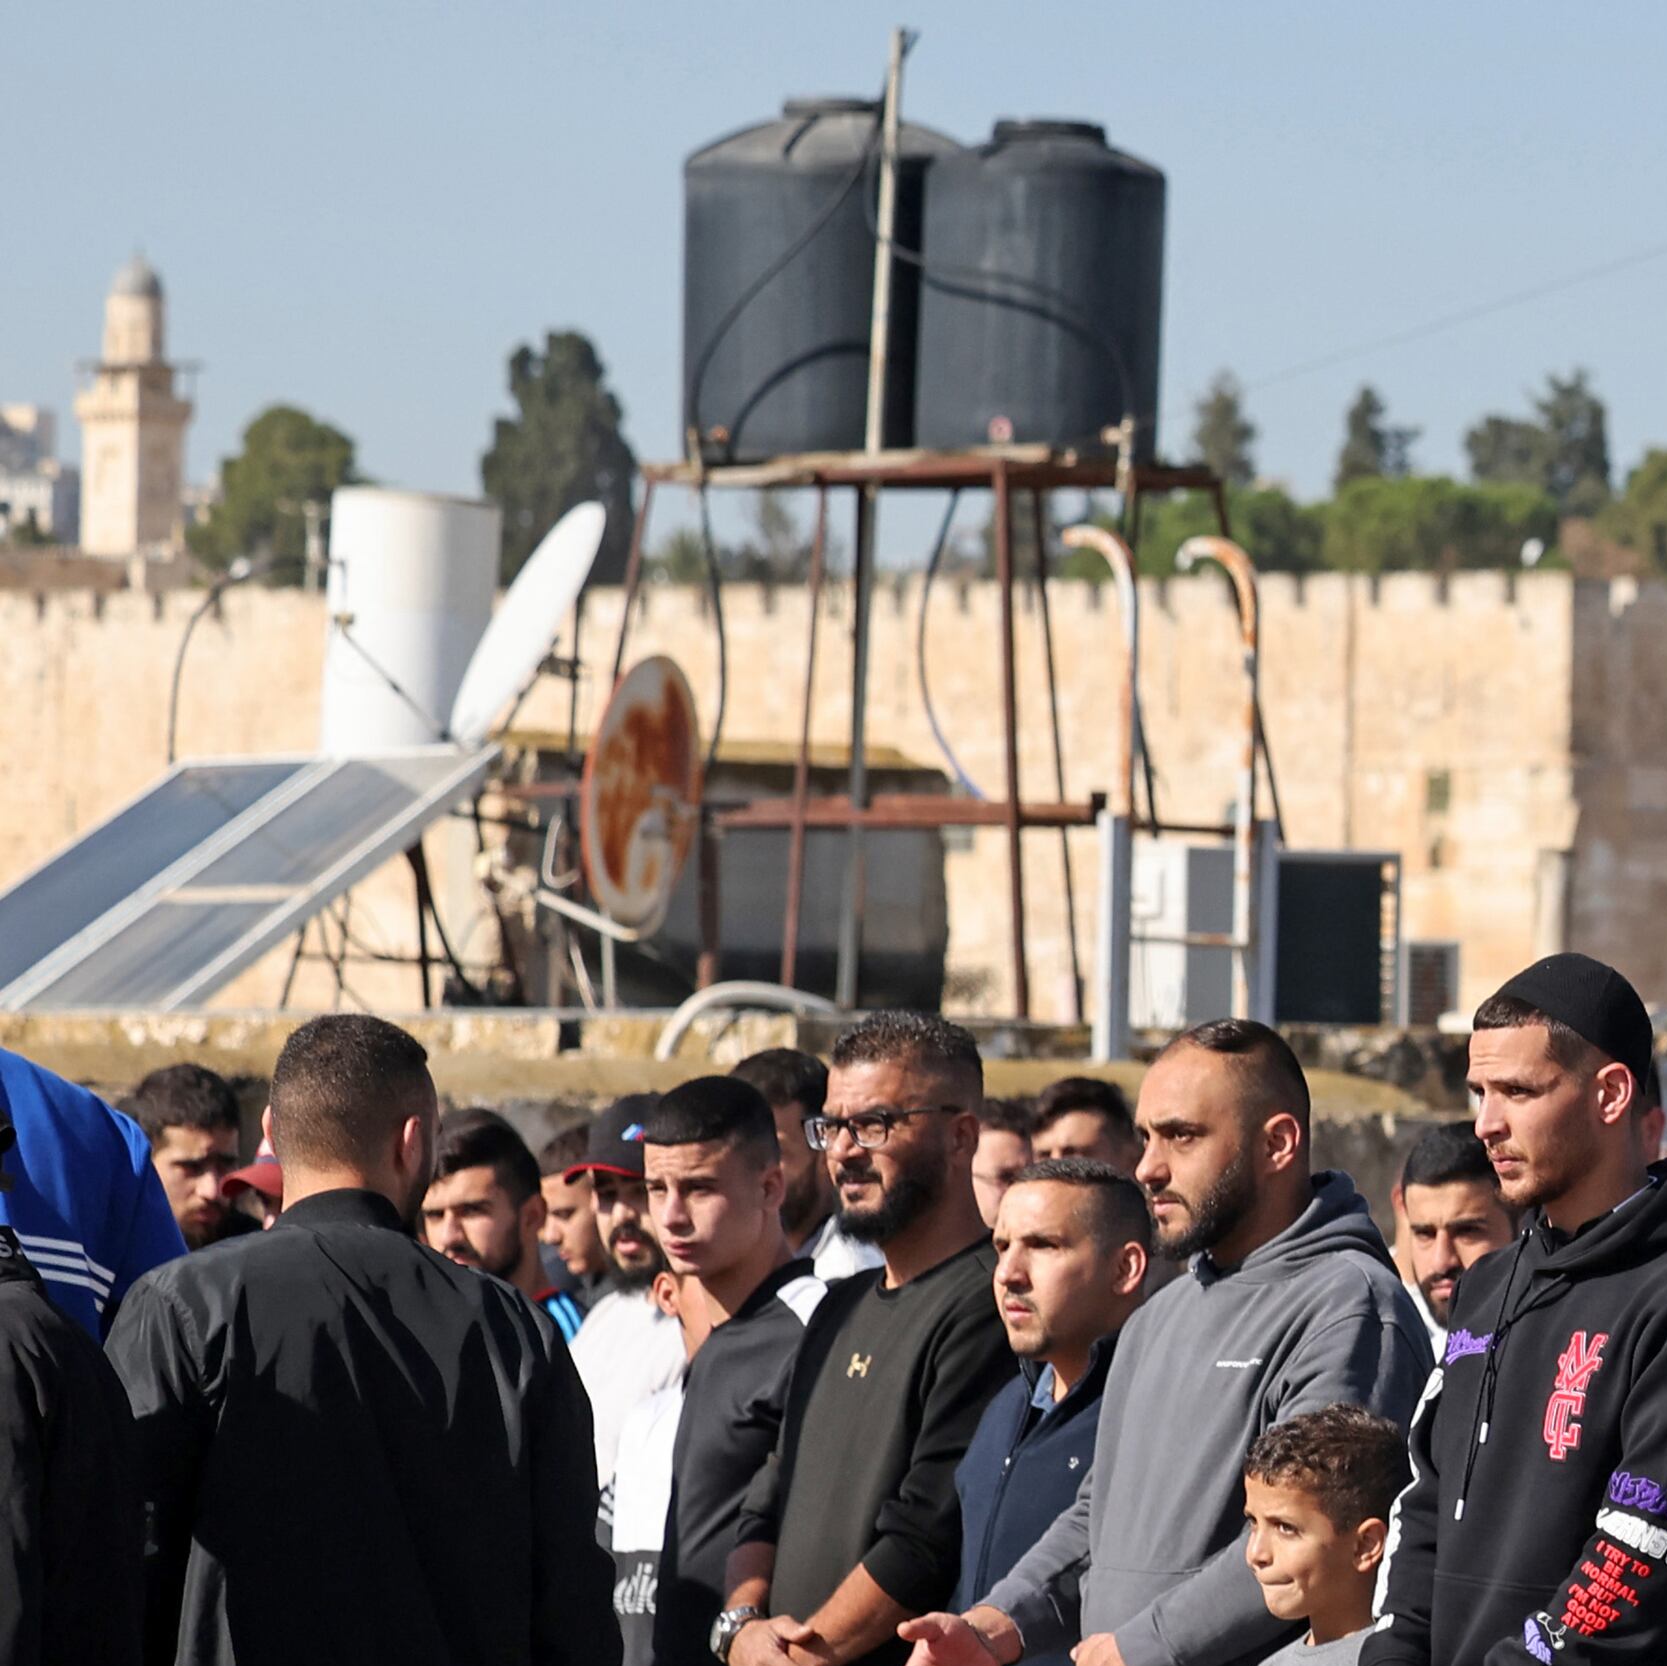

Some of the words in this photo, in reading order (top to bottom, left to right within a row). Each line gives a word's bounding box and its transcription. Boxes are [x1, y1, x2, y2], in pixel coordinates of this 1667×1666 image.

[1595, 1540, 1606, 1553] I
[1603, 1543, 1631, 1567] TRY
[1631, 1559, 1652, 1578] TO
[1603, 1560, 1624, 1580] BE
[1580, 1560, 1640, 1607] NORMAL,
[1587, 1581, 1617, 1604] BUT
[1566, 1598, 1607, 1630] GOOD
[1567, 1583, 1590, 1604] I'M
[1588, 1597, 1621, 1621] NOT
[1560, 1611, 1580, 1629] AT
